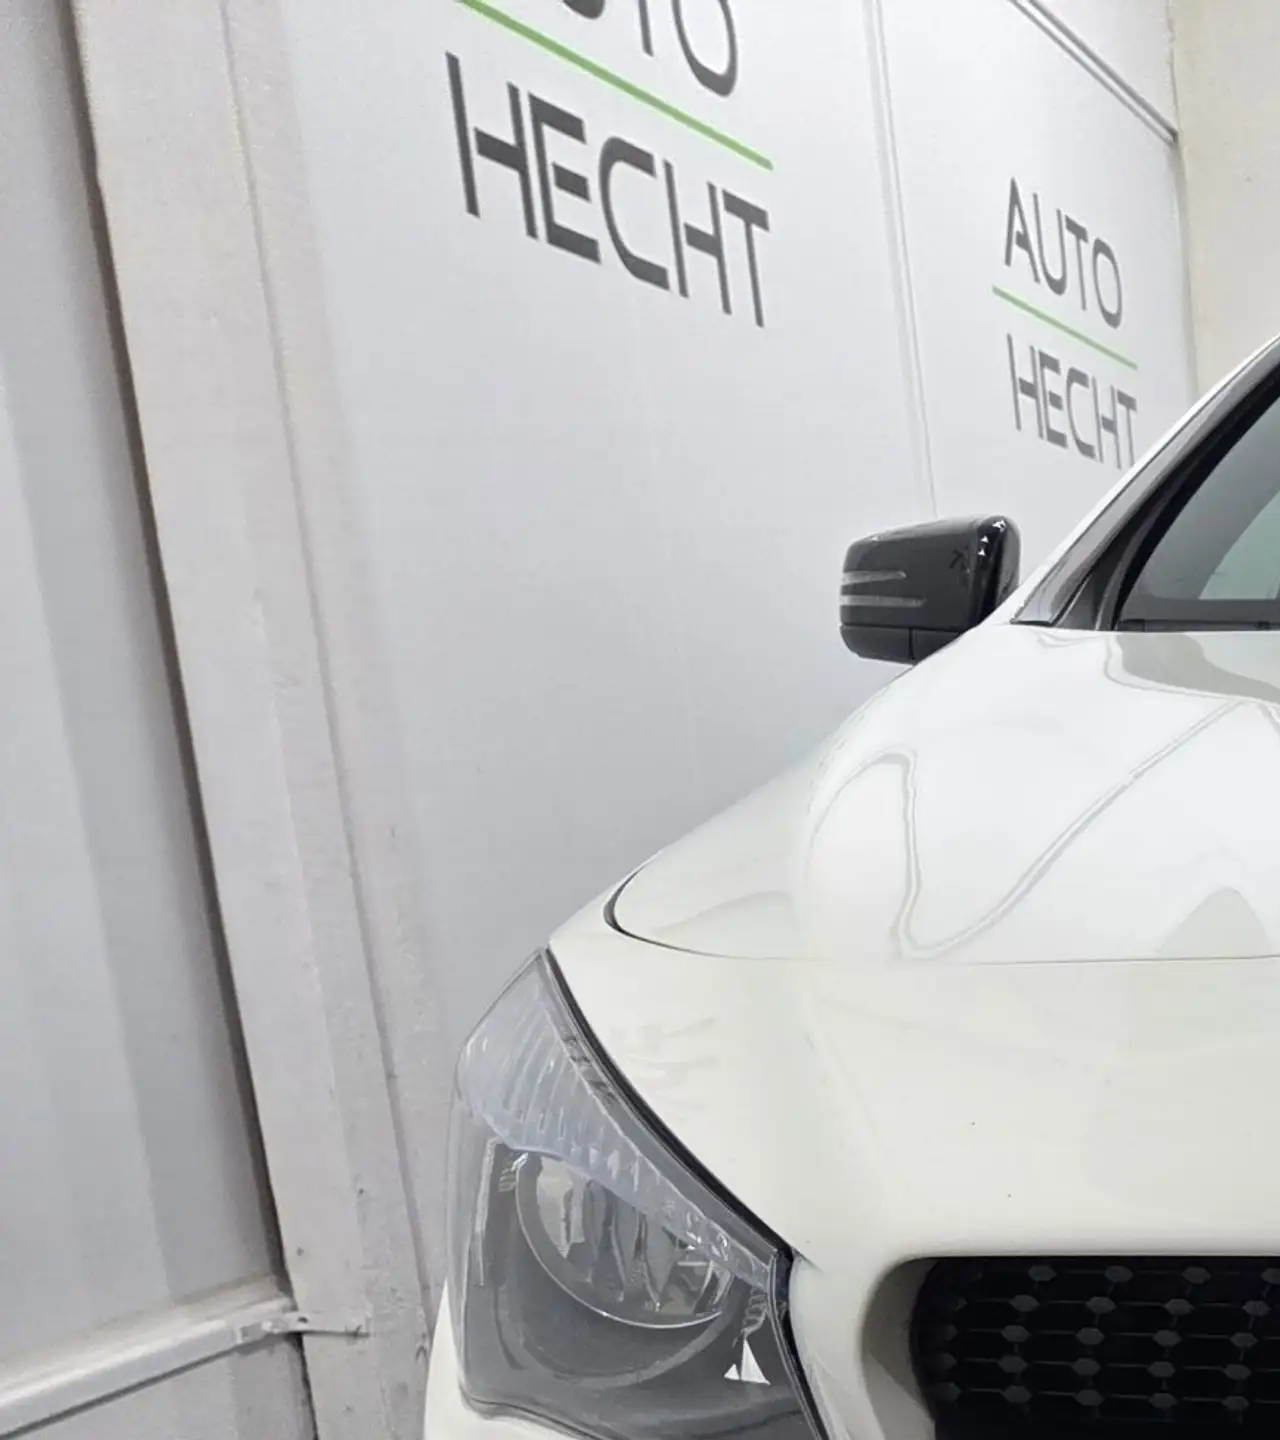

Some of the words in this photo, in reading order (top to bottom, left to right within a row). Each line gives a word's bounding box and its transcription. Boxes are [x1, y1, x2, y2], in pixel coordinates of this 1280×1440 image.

[446, 51, 769, 328] HECHT
[1004, 177, 1123, 330] AUTO
[1006, 333, 1137, 470] HECHT
